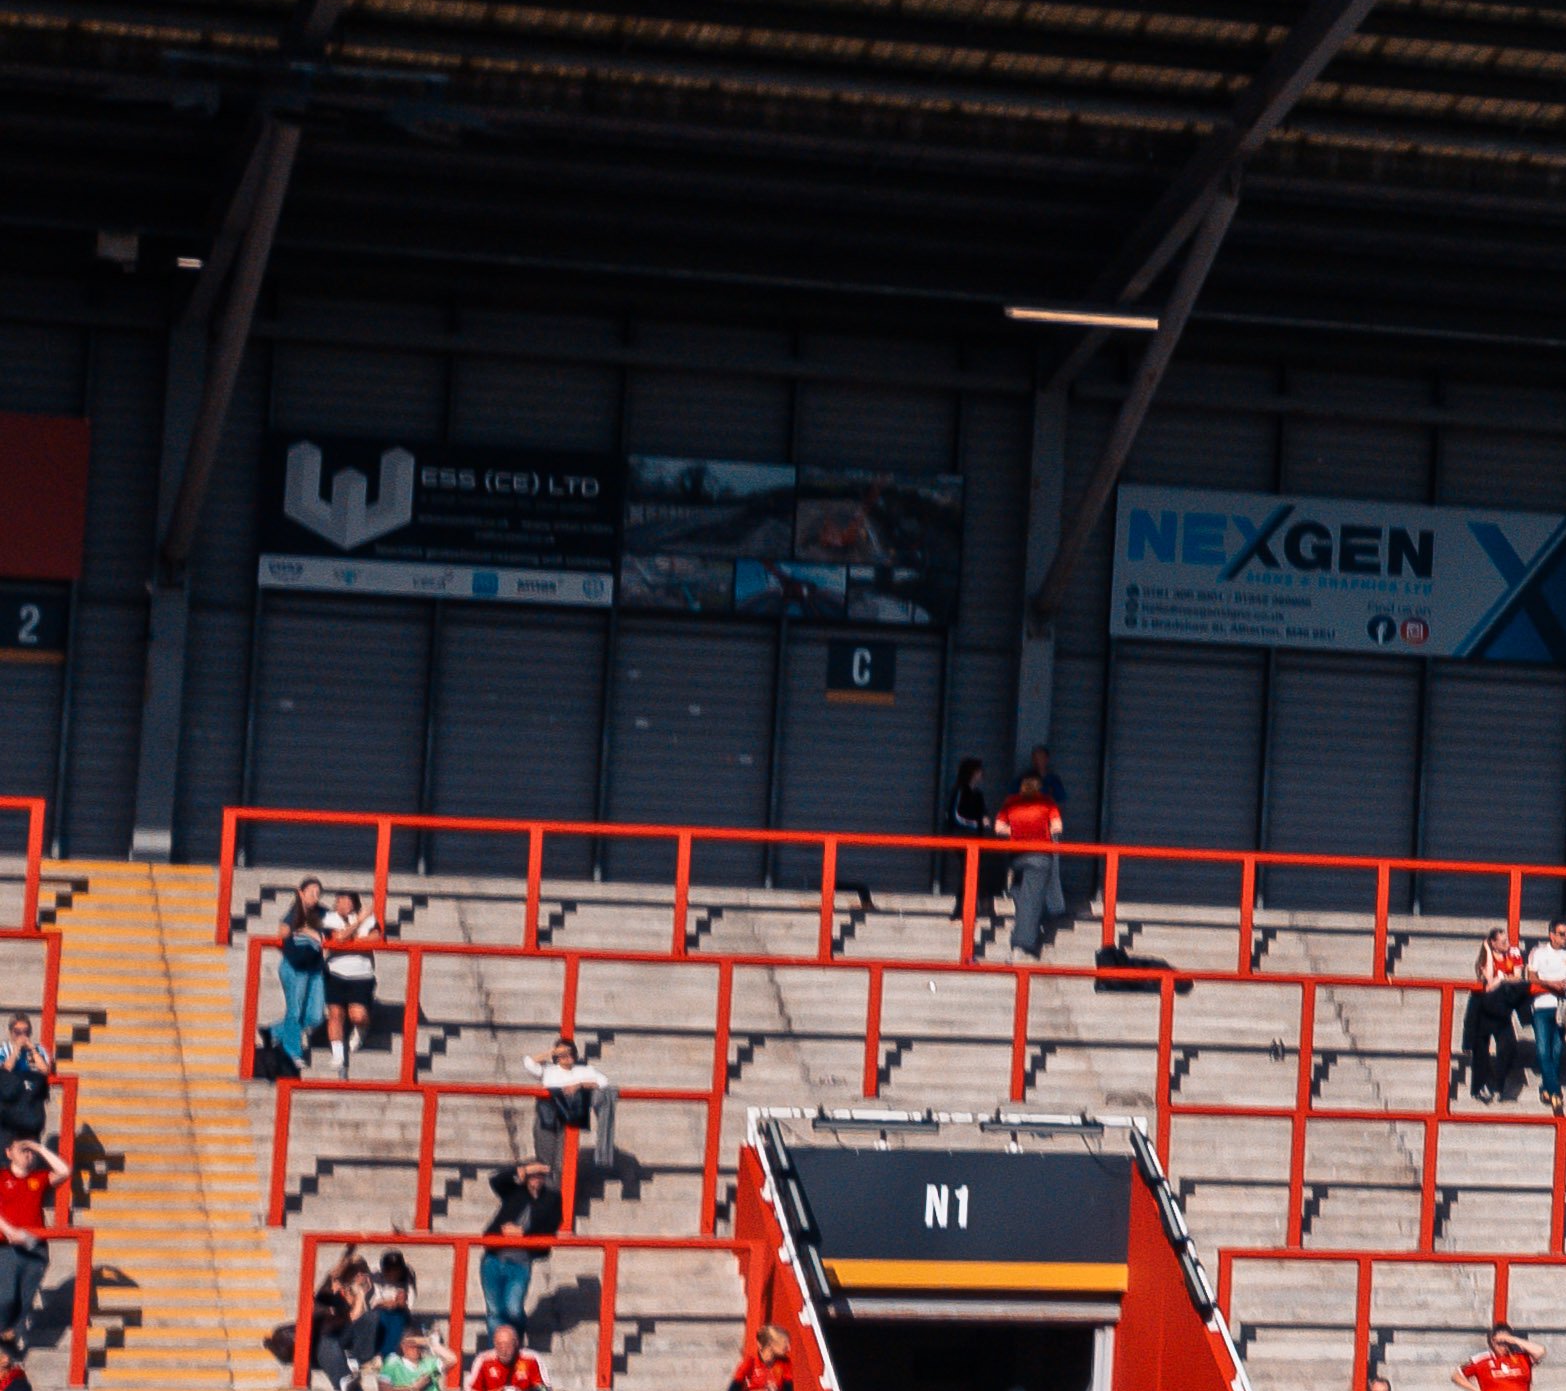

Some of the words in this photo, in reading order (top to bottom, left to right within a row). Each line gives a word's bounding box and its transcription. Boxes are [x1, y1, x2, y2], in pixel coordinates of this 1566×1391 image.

[420, 465, 476, 490] ESS
[484, 468, 541, 497] (CE)
[548, 474, 600, 499] LTD
[1127, 503, 1435, 583] NEXGEN
[18, 603, 40, 644] 2
[852, 646, 871, 686] C
[924, 1183, 969, 1229] N1
